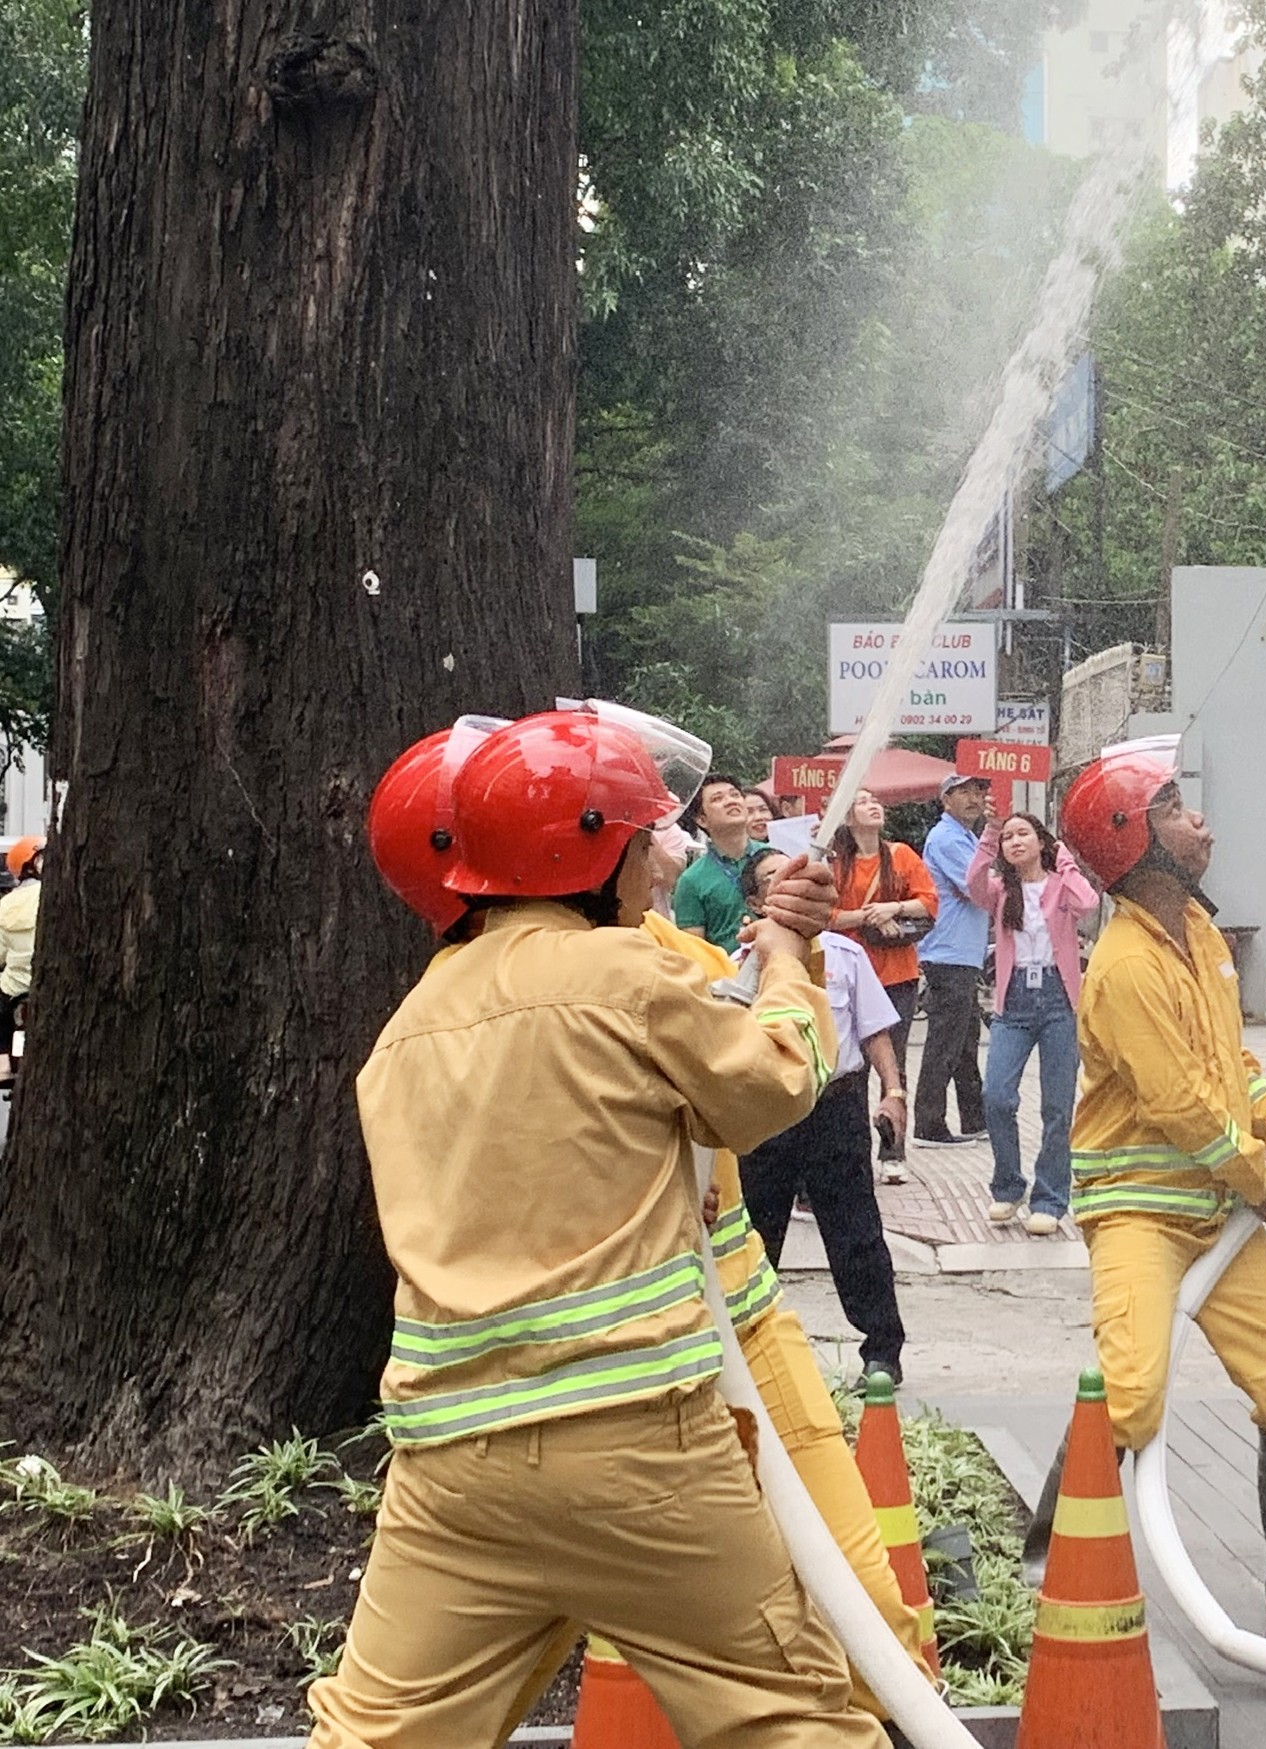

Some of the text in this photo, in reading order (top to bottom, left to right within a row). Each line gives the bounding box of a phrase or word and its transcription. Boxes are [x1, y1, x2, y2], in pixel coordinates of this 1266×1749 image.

[840, 660, 889, 679] POO
[1020, 753, 1031, 773] 6
[827, 769, 836, 788] 5
